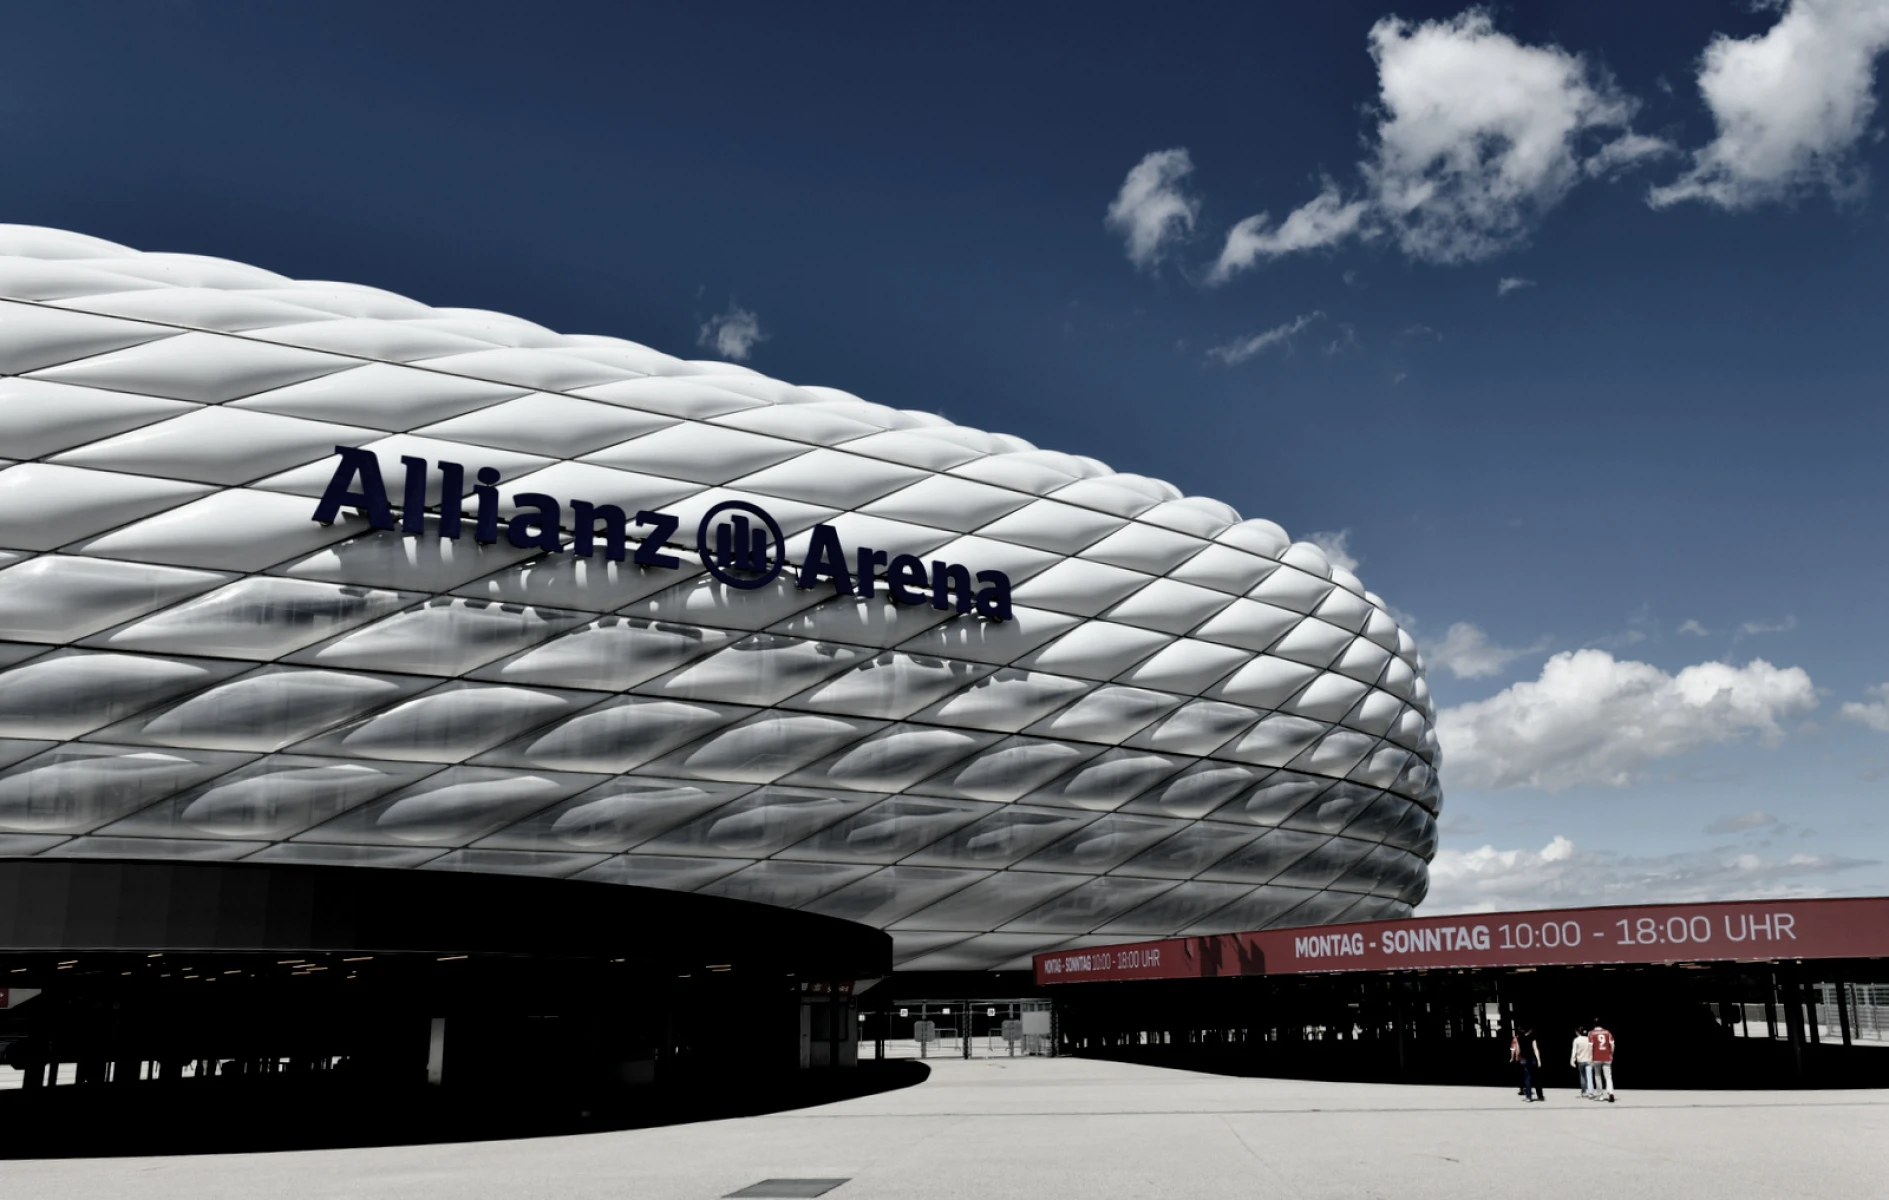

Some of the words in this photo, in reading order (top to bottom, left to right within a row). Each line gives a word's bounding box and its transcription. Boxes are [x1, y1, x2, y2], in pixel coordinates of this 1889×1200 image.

[312, 445, 680, 569] Allianz
[796, 523, 1013, 621] Arena
[1295, 933, 1364, 958] MONTAG
[1382, 925, 1491, 954] SONNTAG
[1498, 921, 1582, 949] 10:00
[1615, 915, 1712, 945] 18:00
[1725, 912, 1797, 942] UHR
[1117, 951, 1140, 970] 18:00
[1141, 948, 1160, 968] UHR
